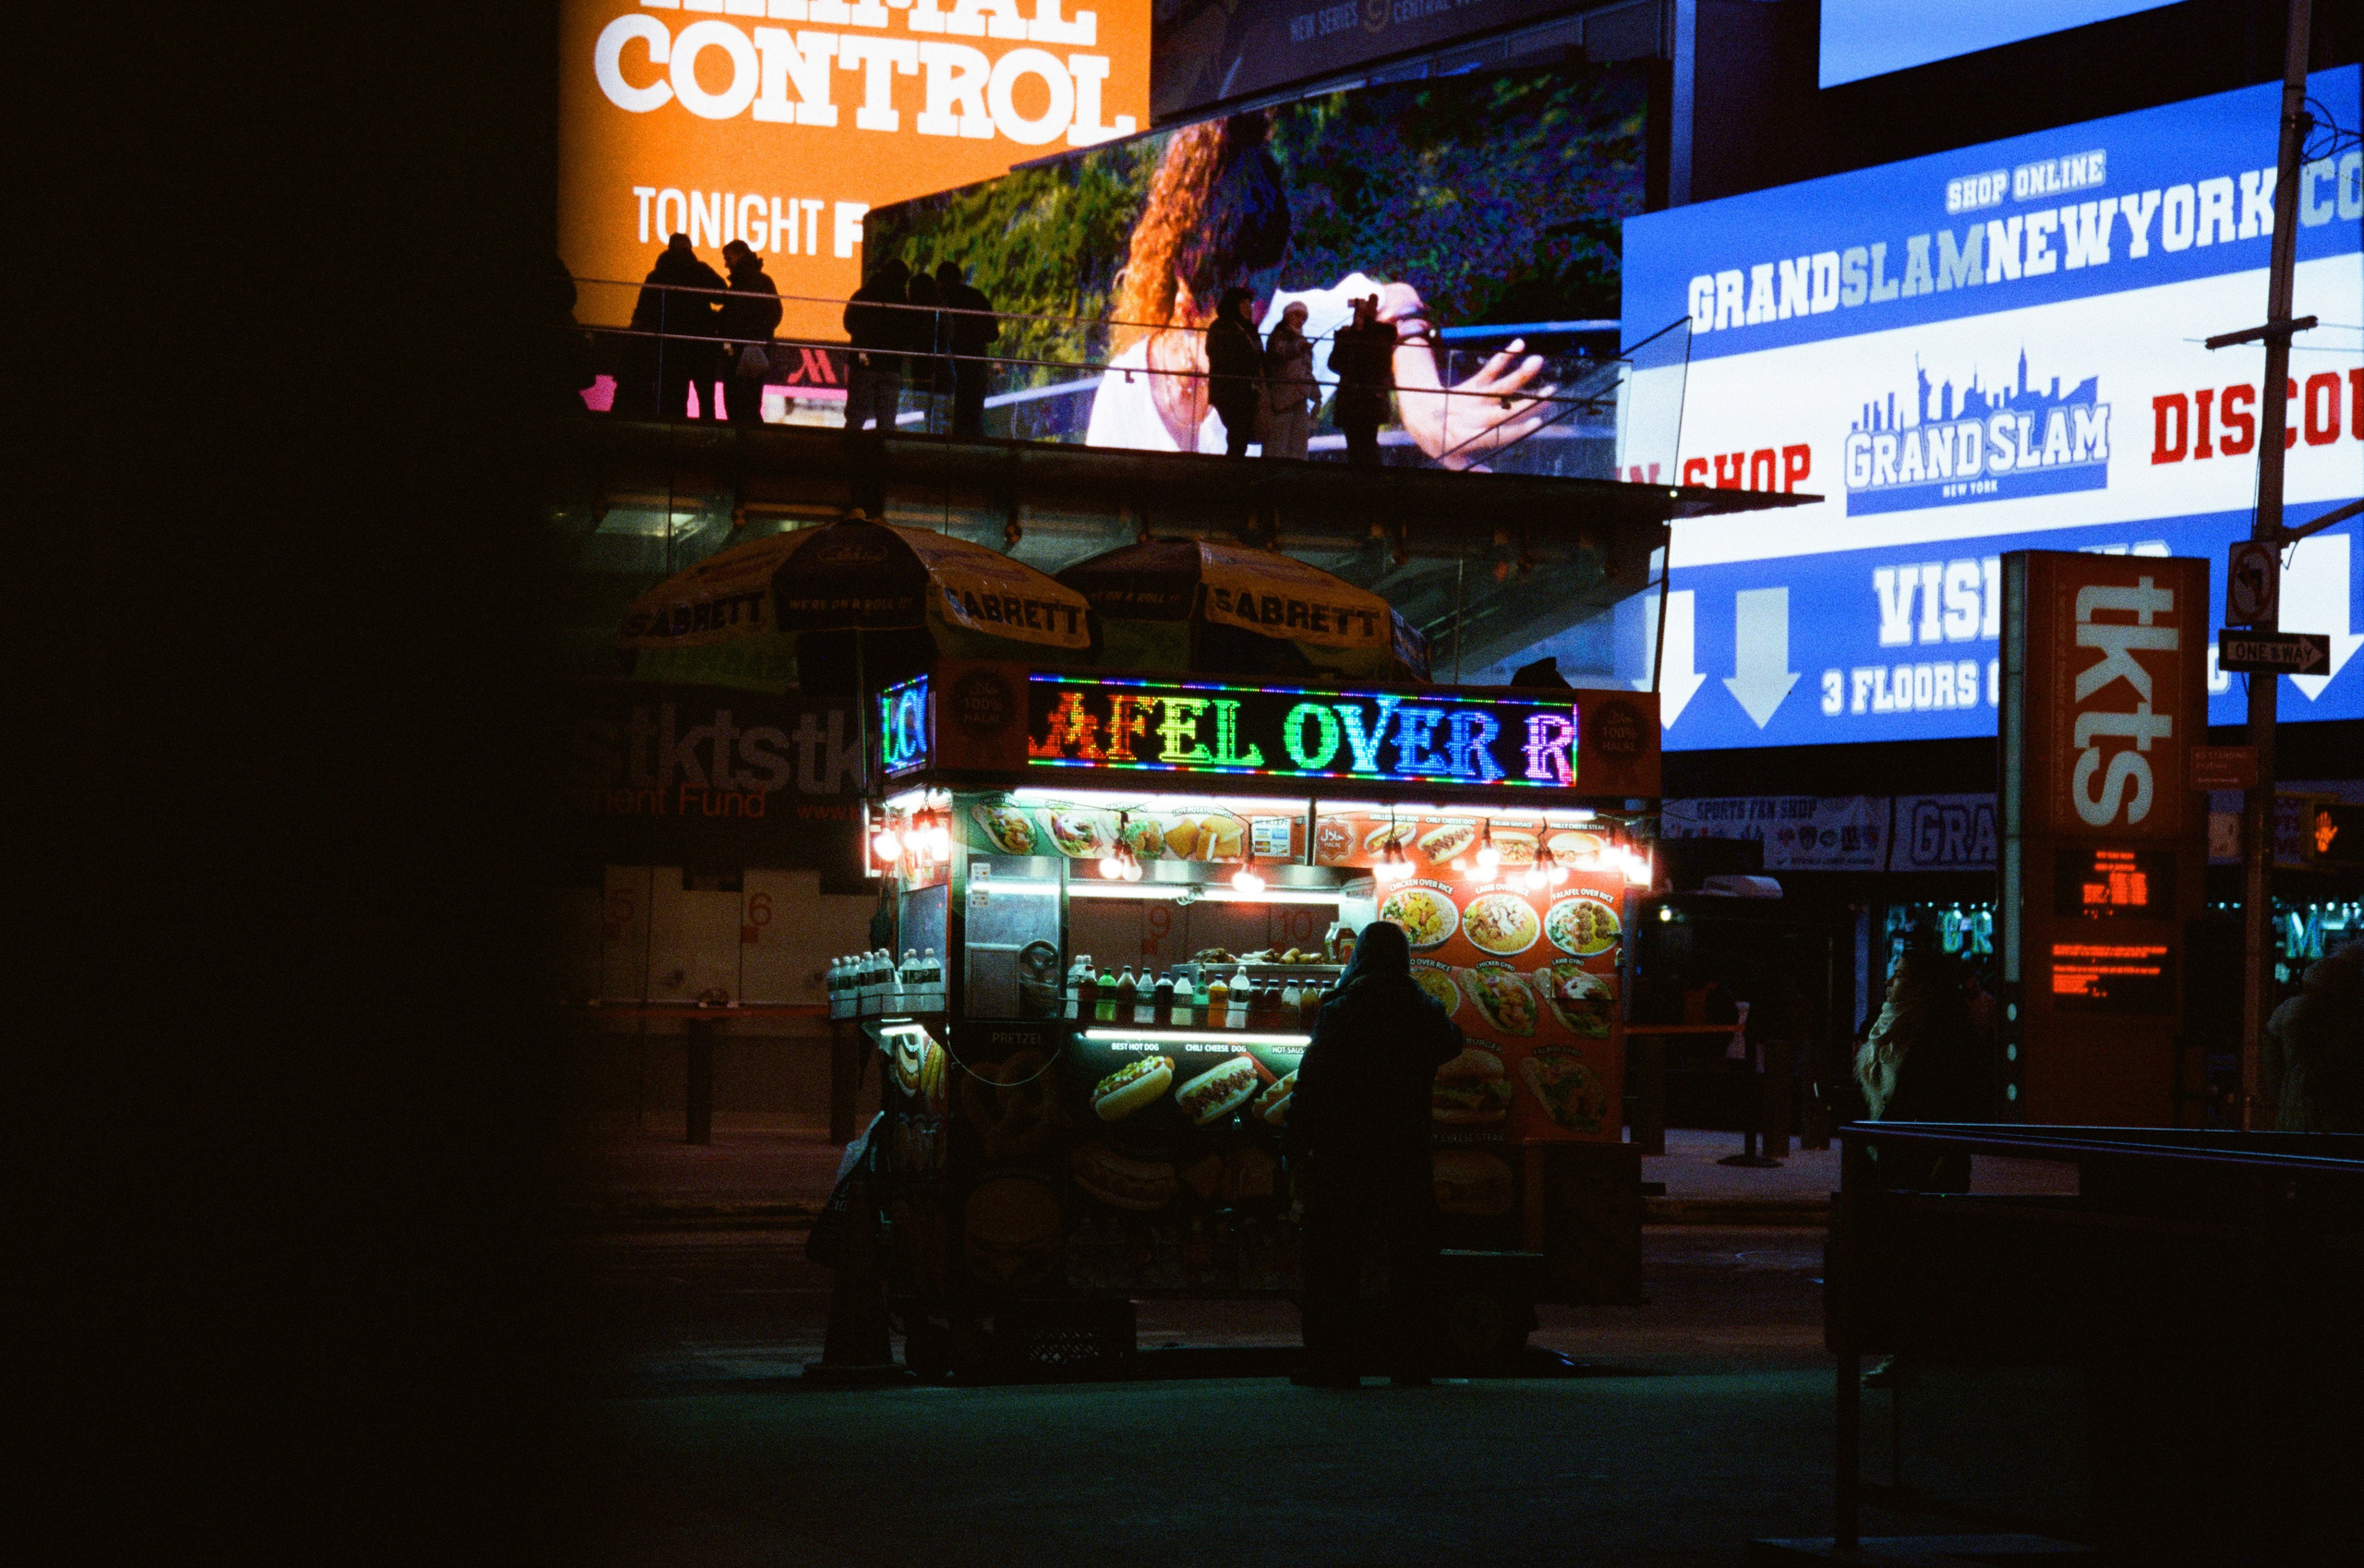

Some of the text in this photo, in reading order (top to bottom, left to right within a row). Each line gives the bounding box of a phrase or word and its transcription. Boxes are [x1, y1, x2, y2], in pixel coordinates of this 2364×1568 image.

[595, 13, 1137, 147] CONTROL
[1947, 150, 2107, 214] SHOP ONLINE
[633, 186, 825, 256] TONIGHT
[1845, 404, 2110, 490] GRAND SLAM
[1943, 479, 1998, 498] NEW YORK
[623, 591, 765, 637] SABRETT
[944, 586, 1081, 634] SABRETT
[1212, 585, 1381, 635] SABRETT
[2236, 643, 2312, 662] ONE WAY
[1822, 669, 1844, 716] 3
[1851, 658, 1978, 714] FLOORS
[2072, 575, 2179, 827] tkts
[1284, 694, 1507, 783] OVER
[1519, 714, 1574, 783] R
[679, 782, 766, 818] Fund
[1696, 797, 1817, 821] SPORTS FAN SHOP
[1189, 806, 1212, 815] POTATO
[1369, 814, 1394, 822] GRILLED
[1442, 816, 1464, 825] CHEESE
[1550, 821, 1569, 829] PHILLY
[1569, 822, 1588, 830] CHEESE
[1321, 828, 1345, 842] حلال
[1389, 878, 1454, 895] CHICKEN OVER RICE
[1476, 884, 1495, 894] LAMB
[1496, 884, 1515, 892] OVER
[1552, 888, 1614, 903] FALAFEL OVER RICE
[748, 891, 772, 924] 6
[1149, 905, 1172, 939] 9
[1279, 909, 1313, 942] 10
[1417, 959, 1435, 967] OVER
[1436, 961, 1452, 973] RICE
[1476, 960, 1515, 971] CHICKEN GYRO
[1551, 958, 1585, 967] LAMB GYRO
[1112, 1043, 1159, 1052] BEST HOT DOG
[1185, 1043, 1247, 1053] CHILI CHEESE DOG
[1272, 1045, 1286, 1055] HOT
